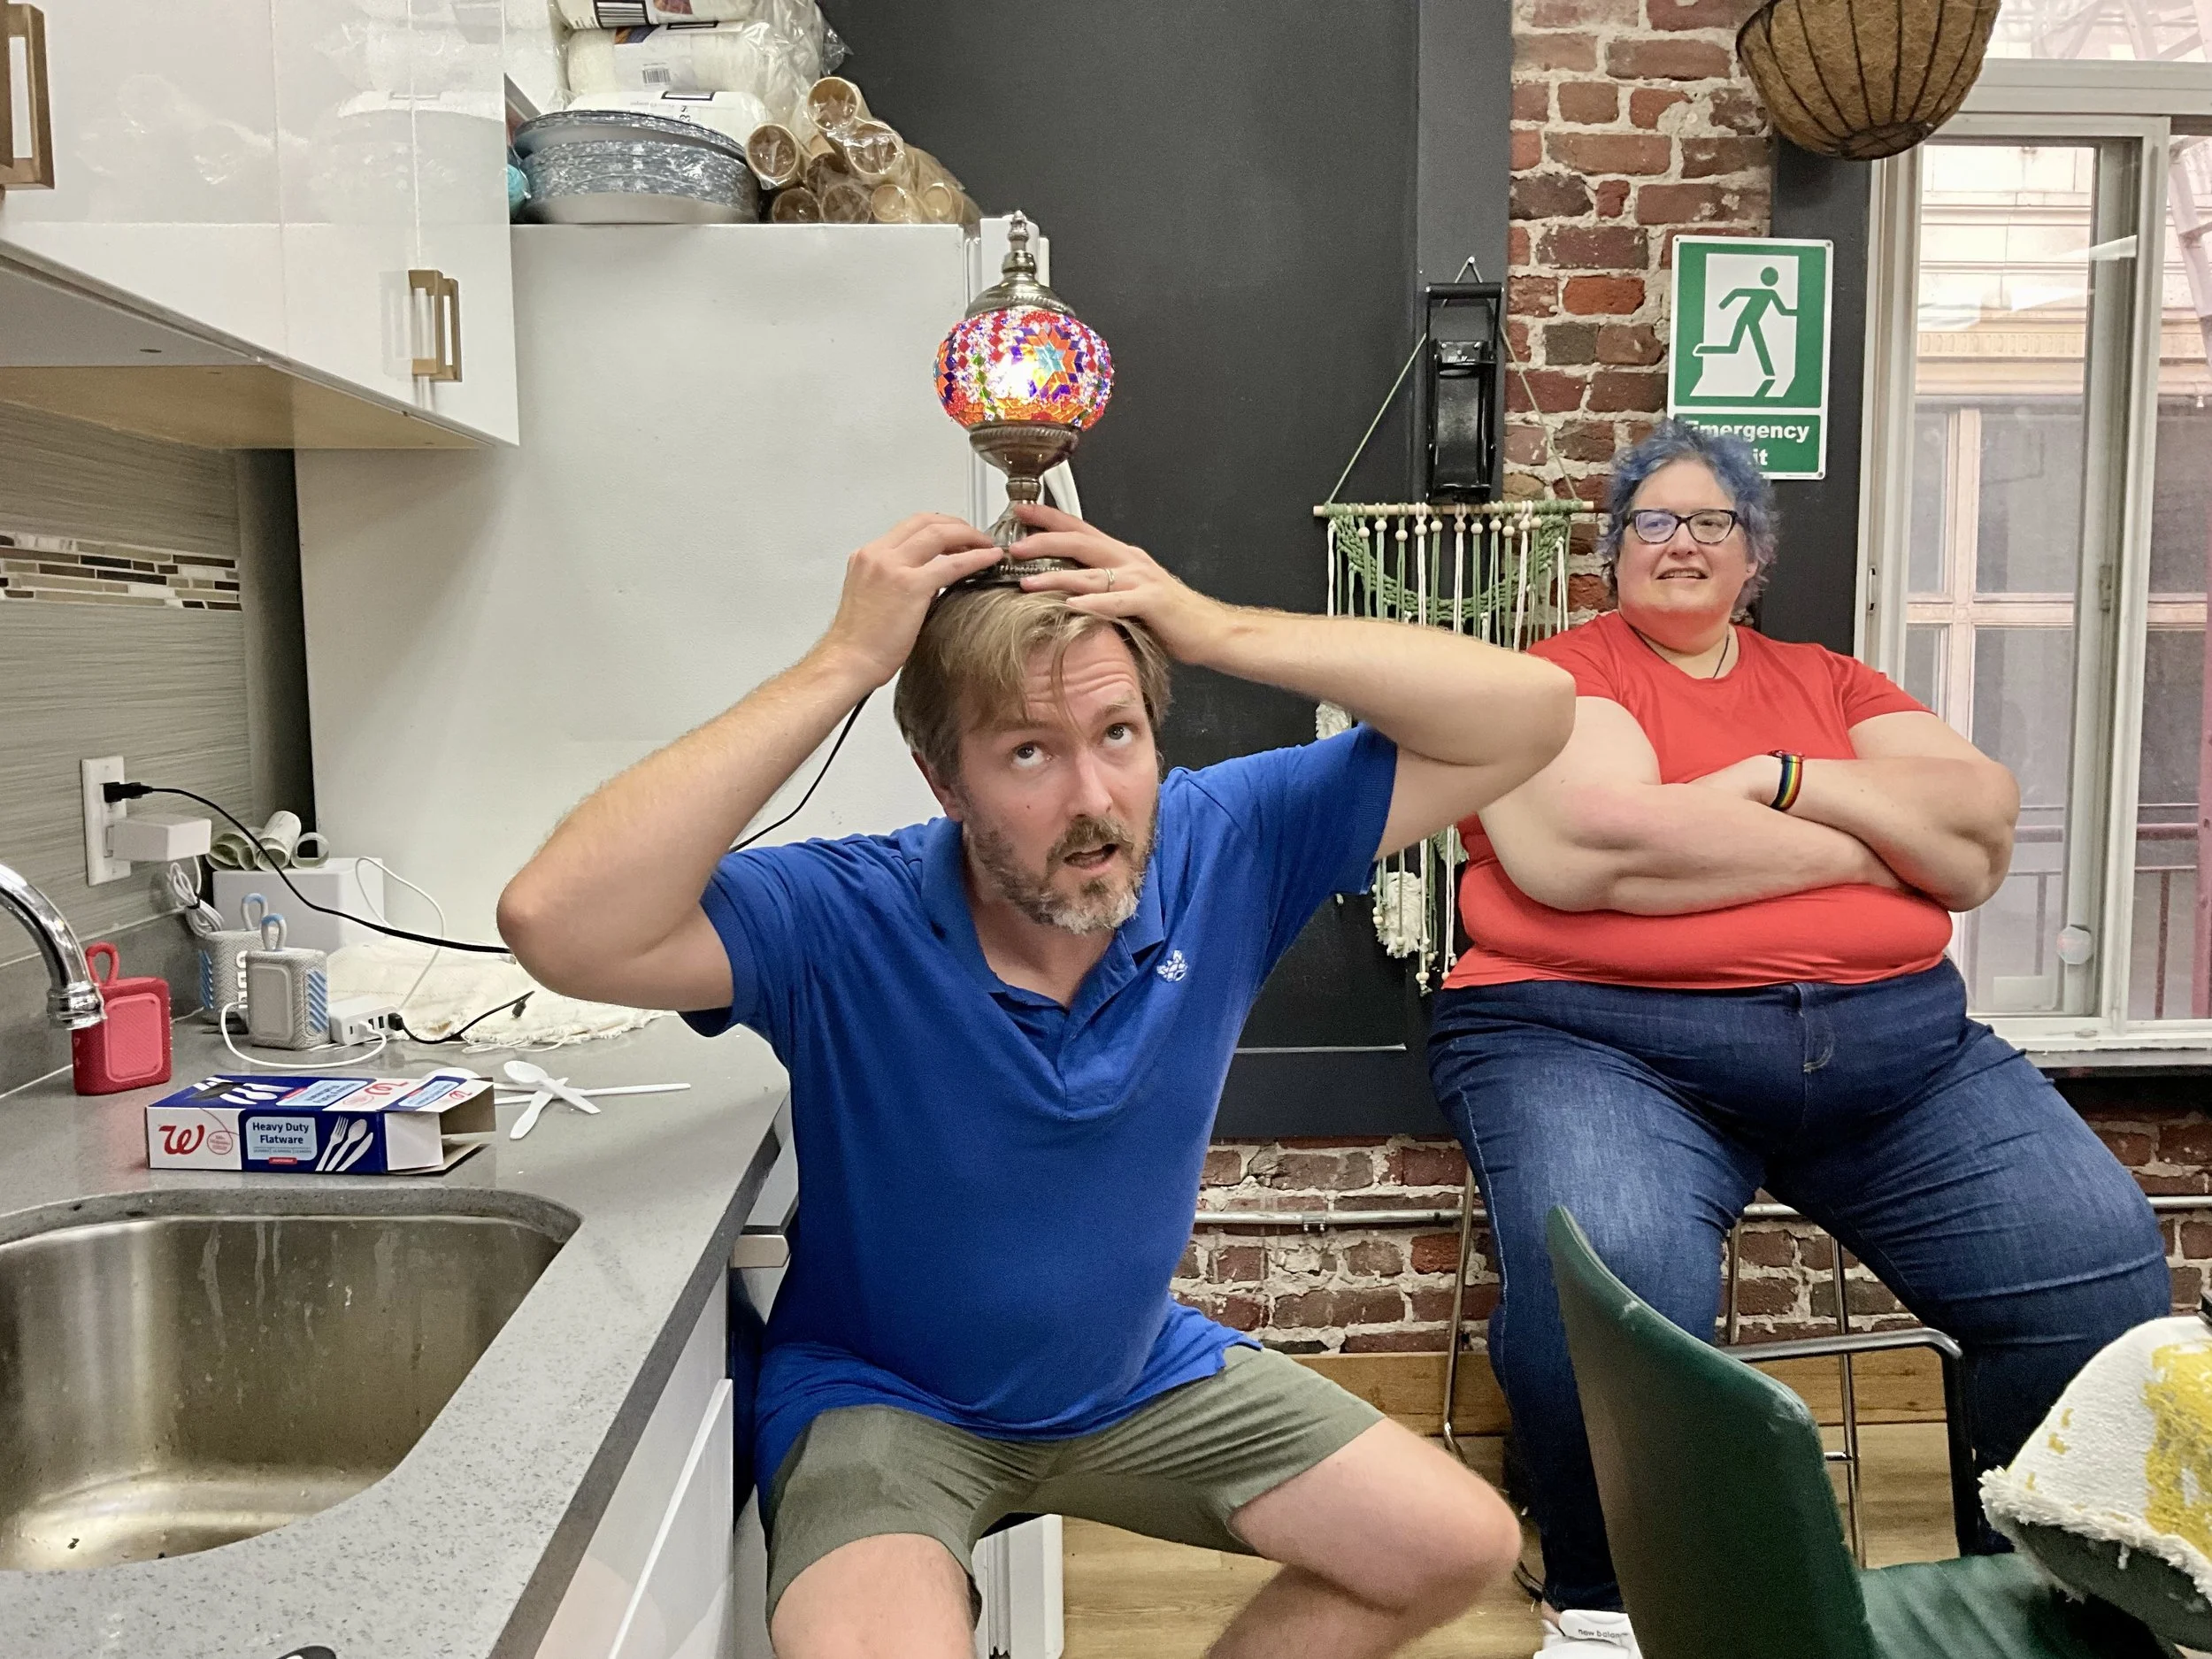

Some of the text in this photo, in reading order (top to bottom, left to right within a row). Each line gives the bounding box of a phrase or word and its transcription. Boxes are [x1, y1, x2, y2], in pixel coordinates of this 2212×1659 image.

[252, 1122, 310, 1133] Heavy Duty
[259, 1134, 303, 1144] Flatware
